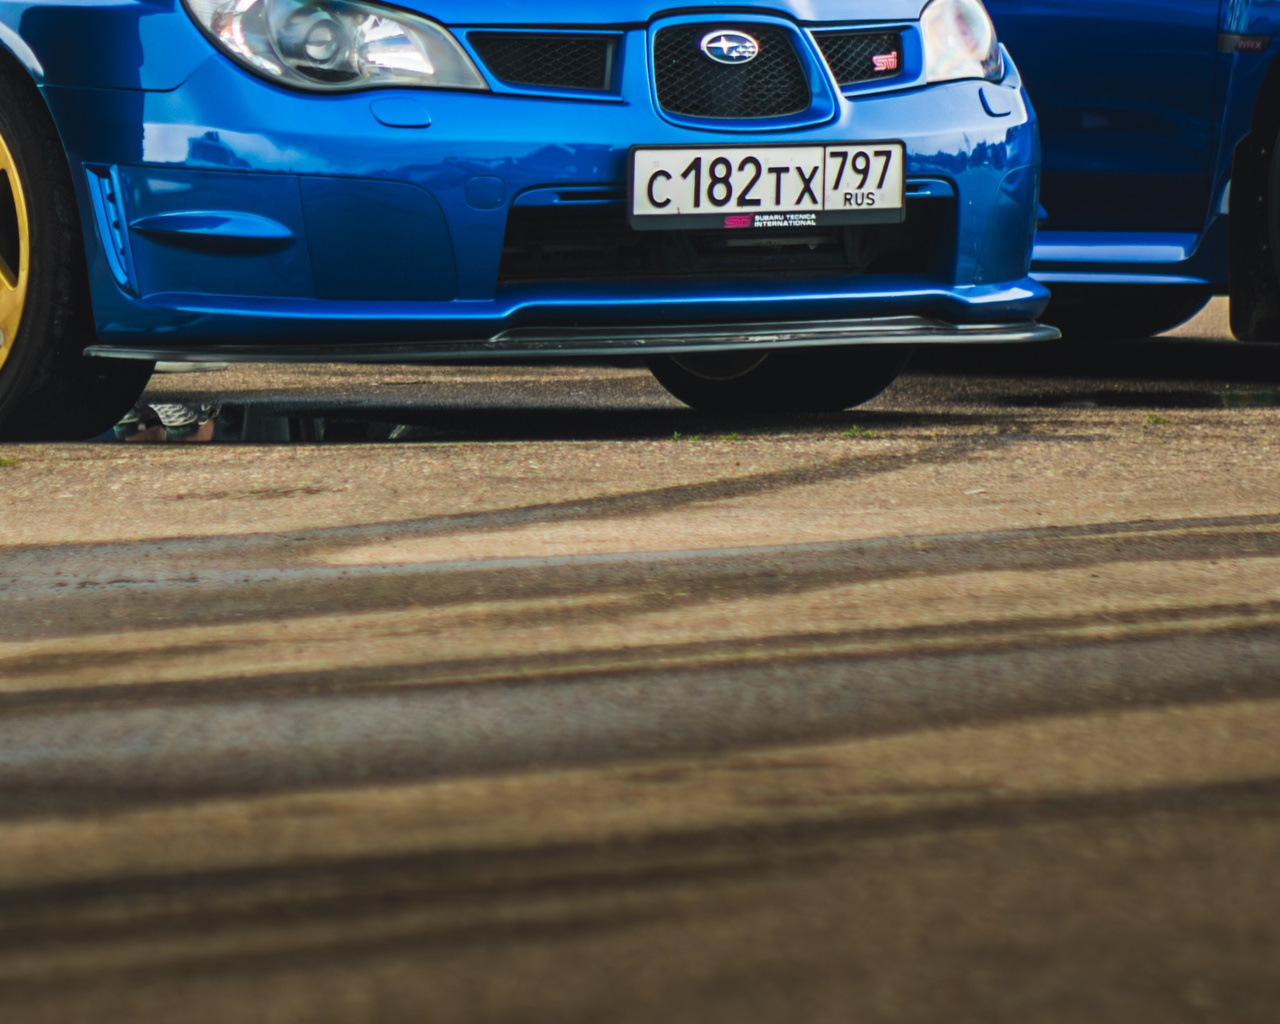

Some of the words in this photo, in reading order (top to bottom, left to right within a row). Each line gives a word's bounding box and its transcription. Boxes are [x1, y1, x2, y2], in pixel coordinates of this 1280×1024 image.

[829, 150, 892, 190] 797
[843, 192, 876, 206] RUS
[754, 214, 784, 222] SUBARU
[786, 213, 816, 221] TECNICA
[754, 220, 816, 228] INTERNATIONAL
